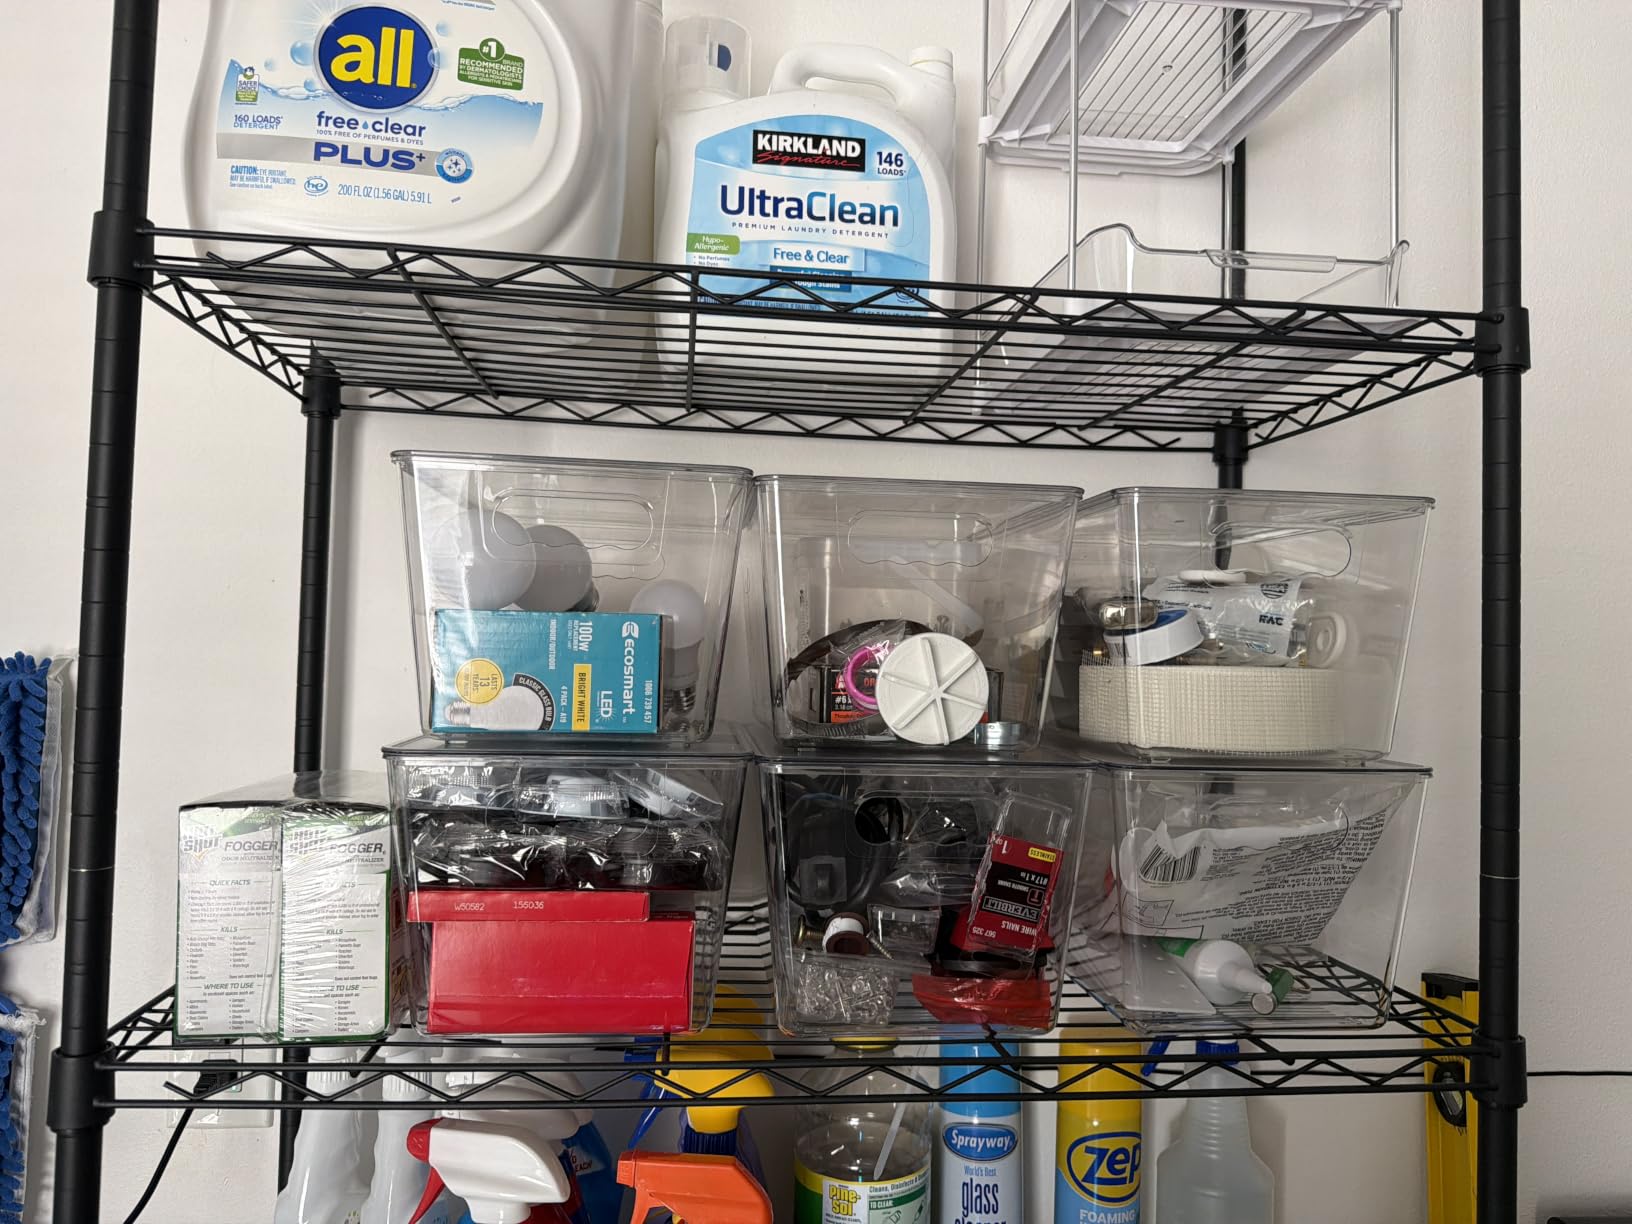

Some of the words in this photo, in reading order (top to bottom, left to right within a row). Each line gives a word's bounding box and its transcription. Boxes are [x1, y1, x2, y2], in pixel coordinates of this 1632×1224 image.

[331, 27, 413, 88] all
[482, 41, 497, 58] #1
[460, 58, 523, 73] RECOMMENDED
[502, 60, 523, 68] BRAND
[467, 66, 522, 80] DERMATOLOGISTS
[233, 122, 279, 130] DETERGENT
[234, 114, 250, 123] 160
[316, 111, 359, 130] free
[372, 117, 426, 137] clear
[364, 134, 399, 143] PERFUMES
[757, 133, 861, 158] KIRKLAND
[756, 150, 860, 167] Signature
[877, 151, 904, 167] 146
[230, 165, 259, 175] CAUTION:
[306, 179, 324, 191] he
[338, 184, 352, 196] 200
[354, 185, 362, 197] FL
[363, 187, 373, 198] OZ
[373, 187, 392, 200] (1.56
[392, 189, 410, 201] GAL)
[410, 191, 425, 203] 5.91
[720, 185, 899, 227] UltraClean
[732, 222, 776, 231] PREMIUM
[781, 225, 827, 234] LAUNDRY
[832, 229, 889, 239] DETERGENT
[694, 242, 730, 253] Allergenic
[702, 236, 724, 244] Hypo-
[773, 247, 801, 261] Free
[804, 249, 814, 262] &
[816, 250, 849, 264] Clear
[480, 677, 490, 687] 13
[490, 674, 498, 691] LASTS
[577, 672, 587, 699] BRIGHT
[518, 676, 541, 692] CLASSIC
[538, 689, 552, 707] GLASS
[560, 690, 568, 706] PACK
[576, 700, 585, 723] WHITE
[600, 690, 613, 718] LED
[643, 710, 652, 724] 457
[1030, 849, 1056, 861] STAINLESS
[454, 902, 486, 911] W50582
[987, 899, 1038, 919] EVERBILT
[1001, 920, 1020, 932] NAILS
[1019, 926, 1037, 936] WIRE
[951, 1129, 1010, 1152] Sprayway
[964, 1165, 984, 1176] World's
[984, 1167, 996, 1176] Best
[829, 1184, 861, 1203] Pine-
[962, 1177, 999, 1218] glass
[832, 1198, 854, 1216] Sol
[1080, 1209, 1136, 1224] FOAMING
